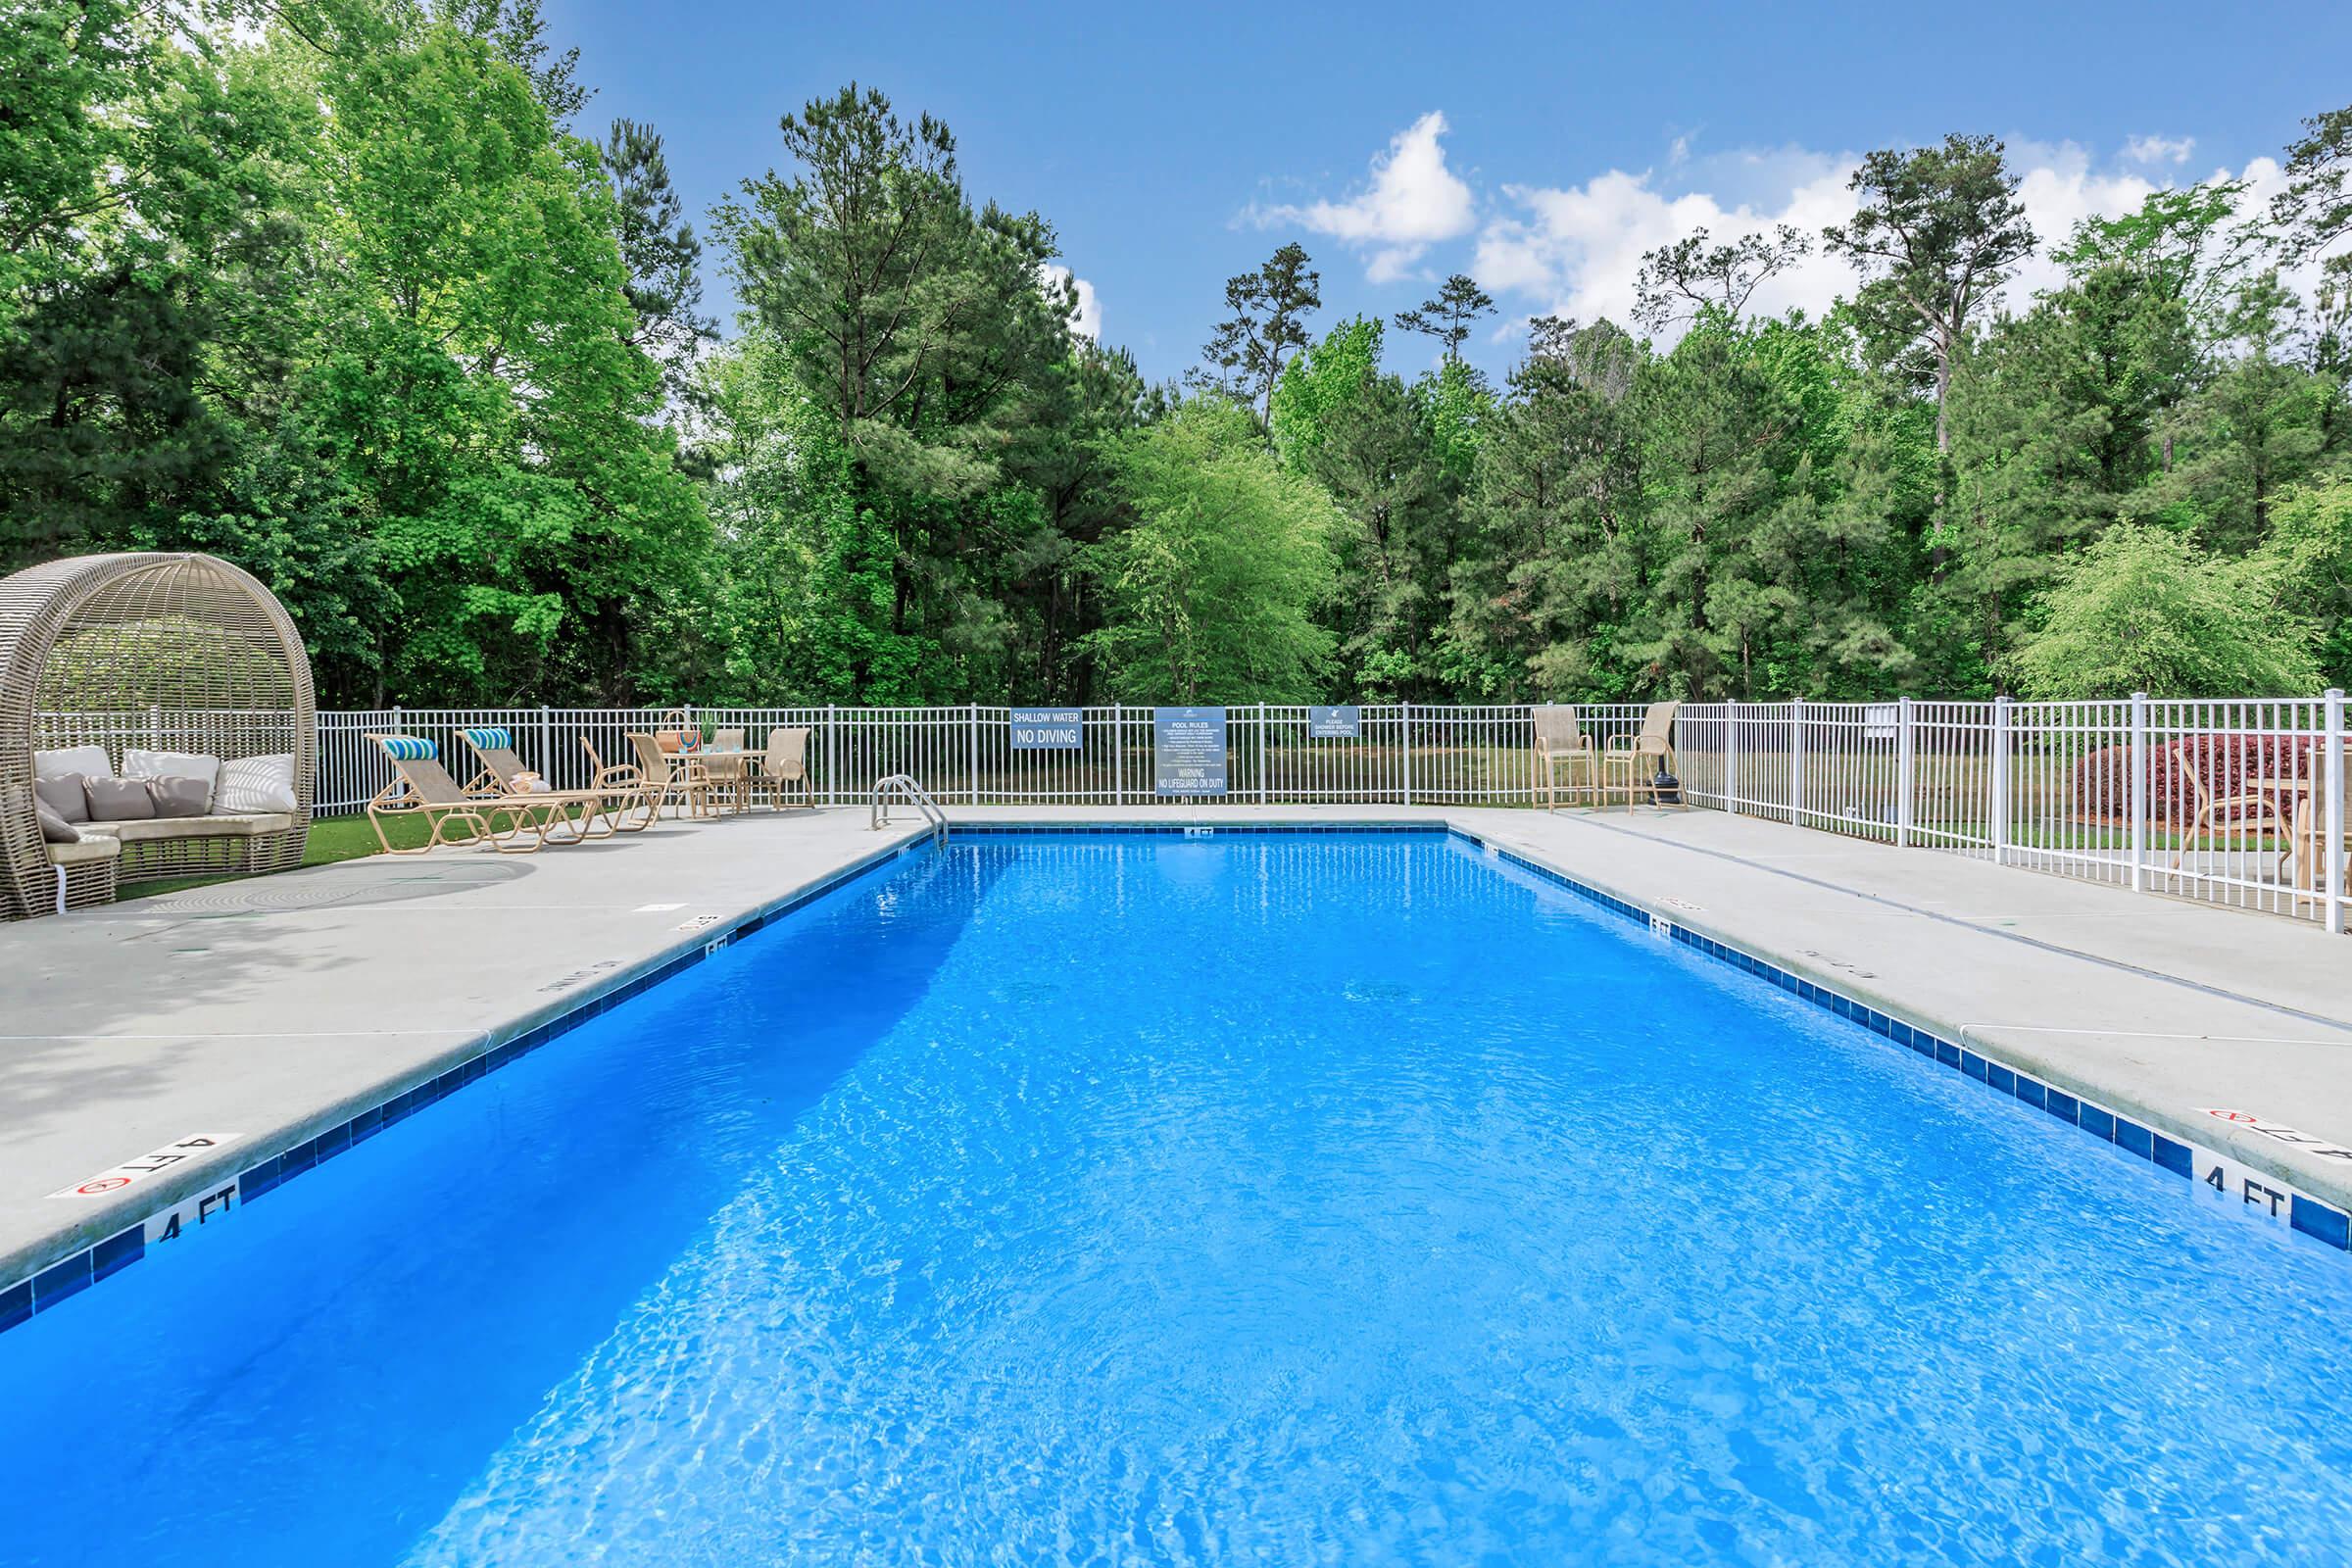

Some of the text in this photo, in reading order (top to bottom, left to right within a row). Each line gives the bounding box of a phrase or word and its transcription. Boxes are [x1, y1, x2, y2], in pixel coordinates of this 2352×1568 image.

[1013, 712, 1079, 722] SHALLOW WATER
[1017, 729, 1076, 744] NO DIVING
[1178, 768, 1204, 777] WARNING
[1158, 778, 1224, 788] NO LIFEGUARD ON DUTY
[2250, 1125, 2324, 1144] FT
[121, 1138, 216, 1172] 4 FT
[2204, 1165, 2285, 1217] 4 FT
[159, 1184, 235, 1243] 4 FT
